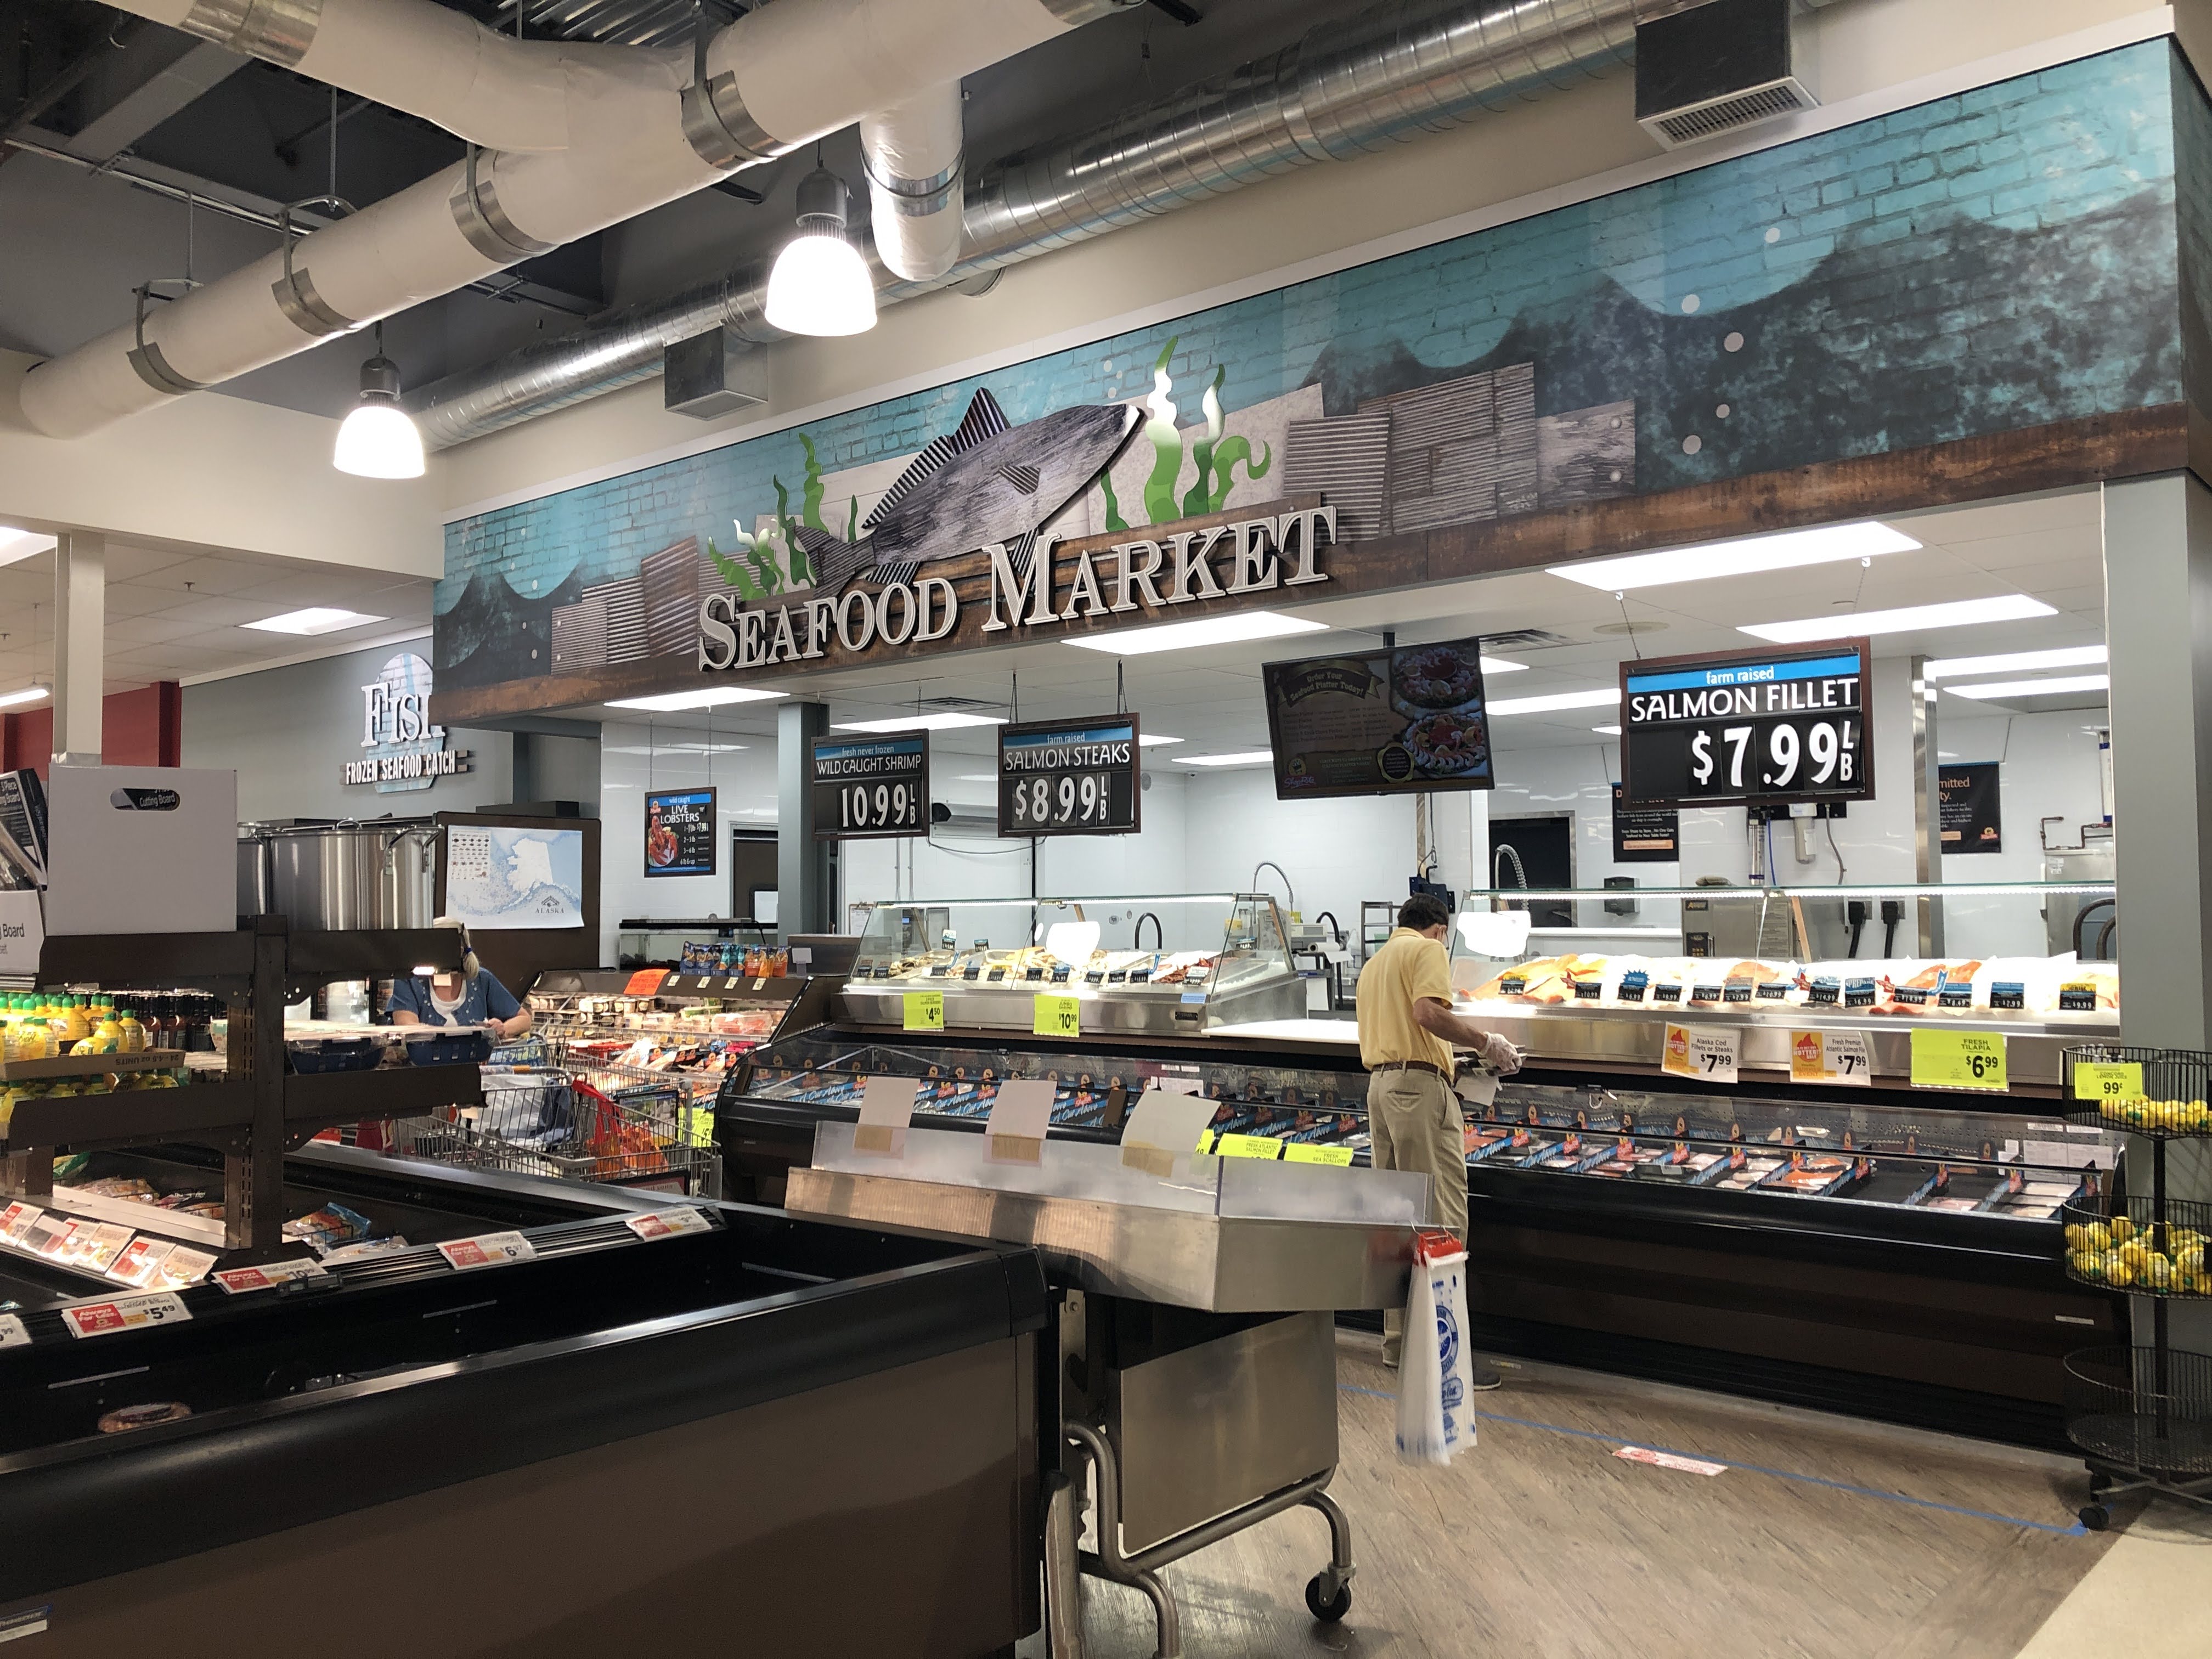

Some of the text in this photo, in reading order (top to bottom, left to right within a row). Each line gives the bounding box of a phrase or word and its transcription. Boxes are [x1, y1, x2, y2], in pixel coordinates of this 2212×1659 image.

[698, 506, 1336, 671] SEAFOOD MARKET
[1706, 665, 1774, 684] farm raised
[1632, 678, 1858, 721] SALMON FILLET
[1047, 731, 1085, 744] farm raised
[842, 745, 894, 756] fresh never frozen
[1006, 743, 1130, 770] SALMON STEAKS
[1692, 722, 1838, 787] $7.99
[346, 750, 455, 785] FROZEN SEAFOOD CATCH
[817, 754, 921, 775] WILD CAUGHT SHRIMP
[139, 792, 175, 806] Cutting Board
[672, 805, 688, 814] LIVE
[841, 783, 906, 827] 10.99
[1015, 776, 1096, 822] $8.99
[661, 812, 699, 824] LOBSTERS
[3, 923, 25, 937] Board
